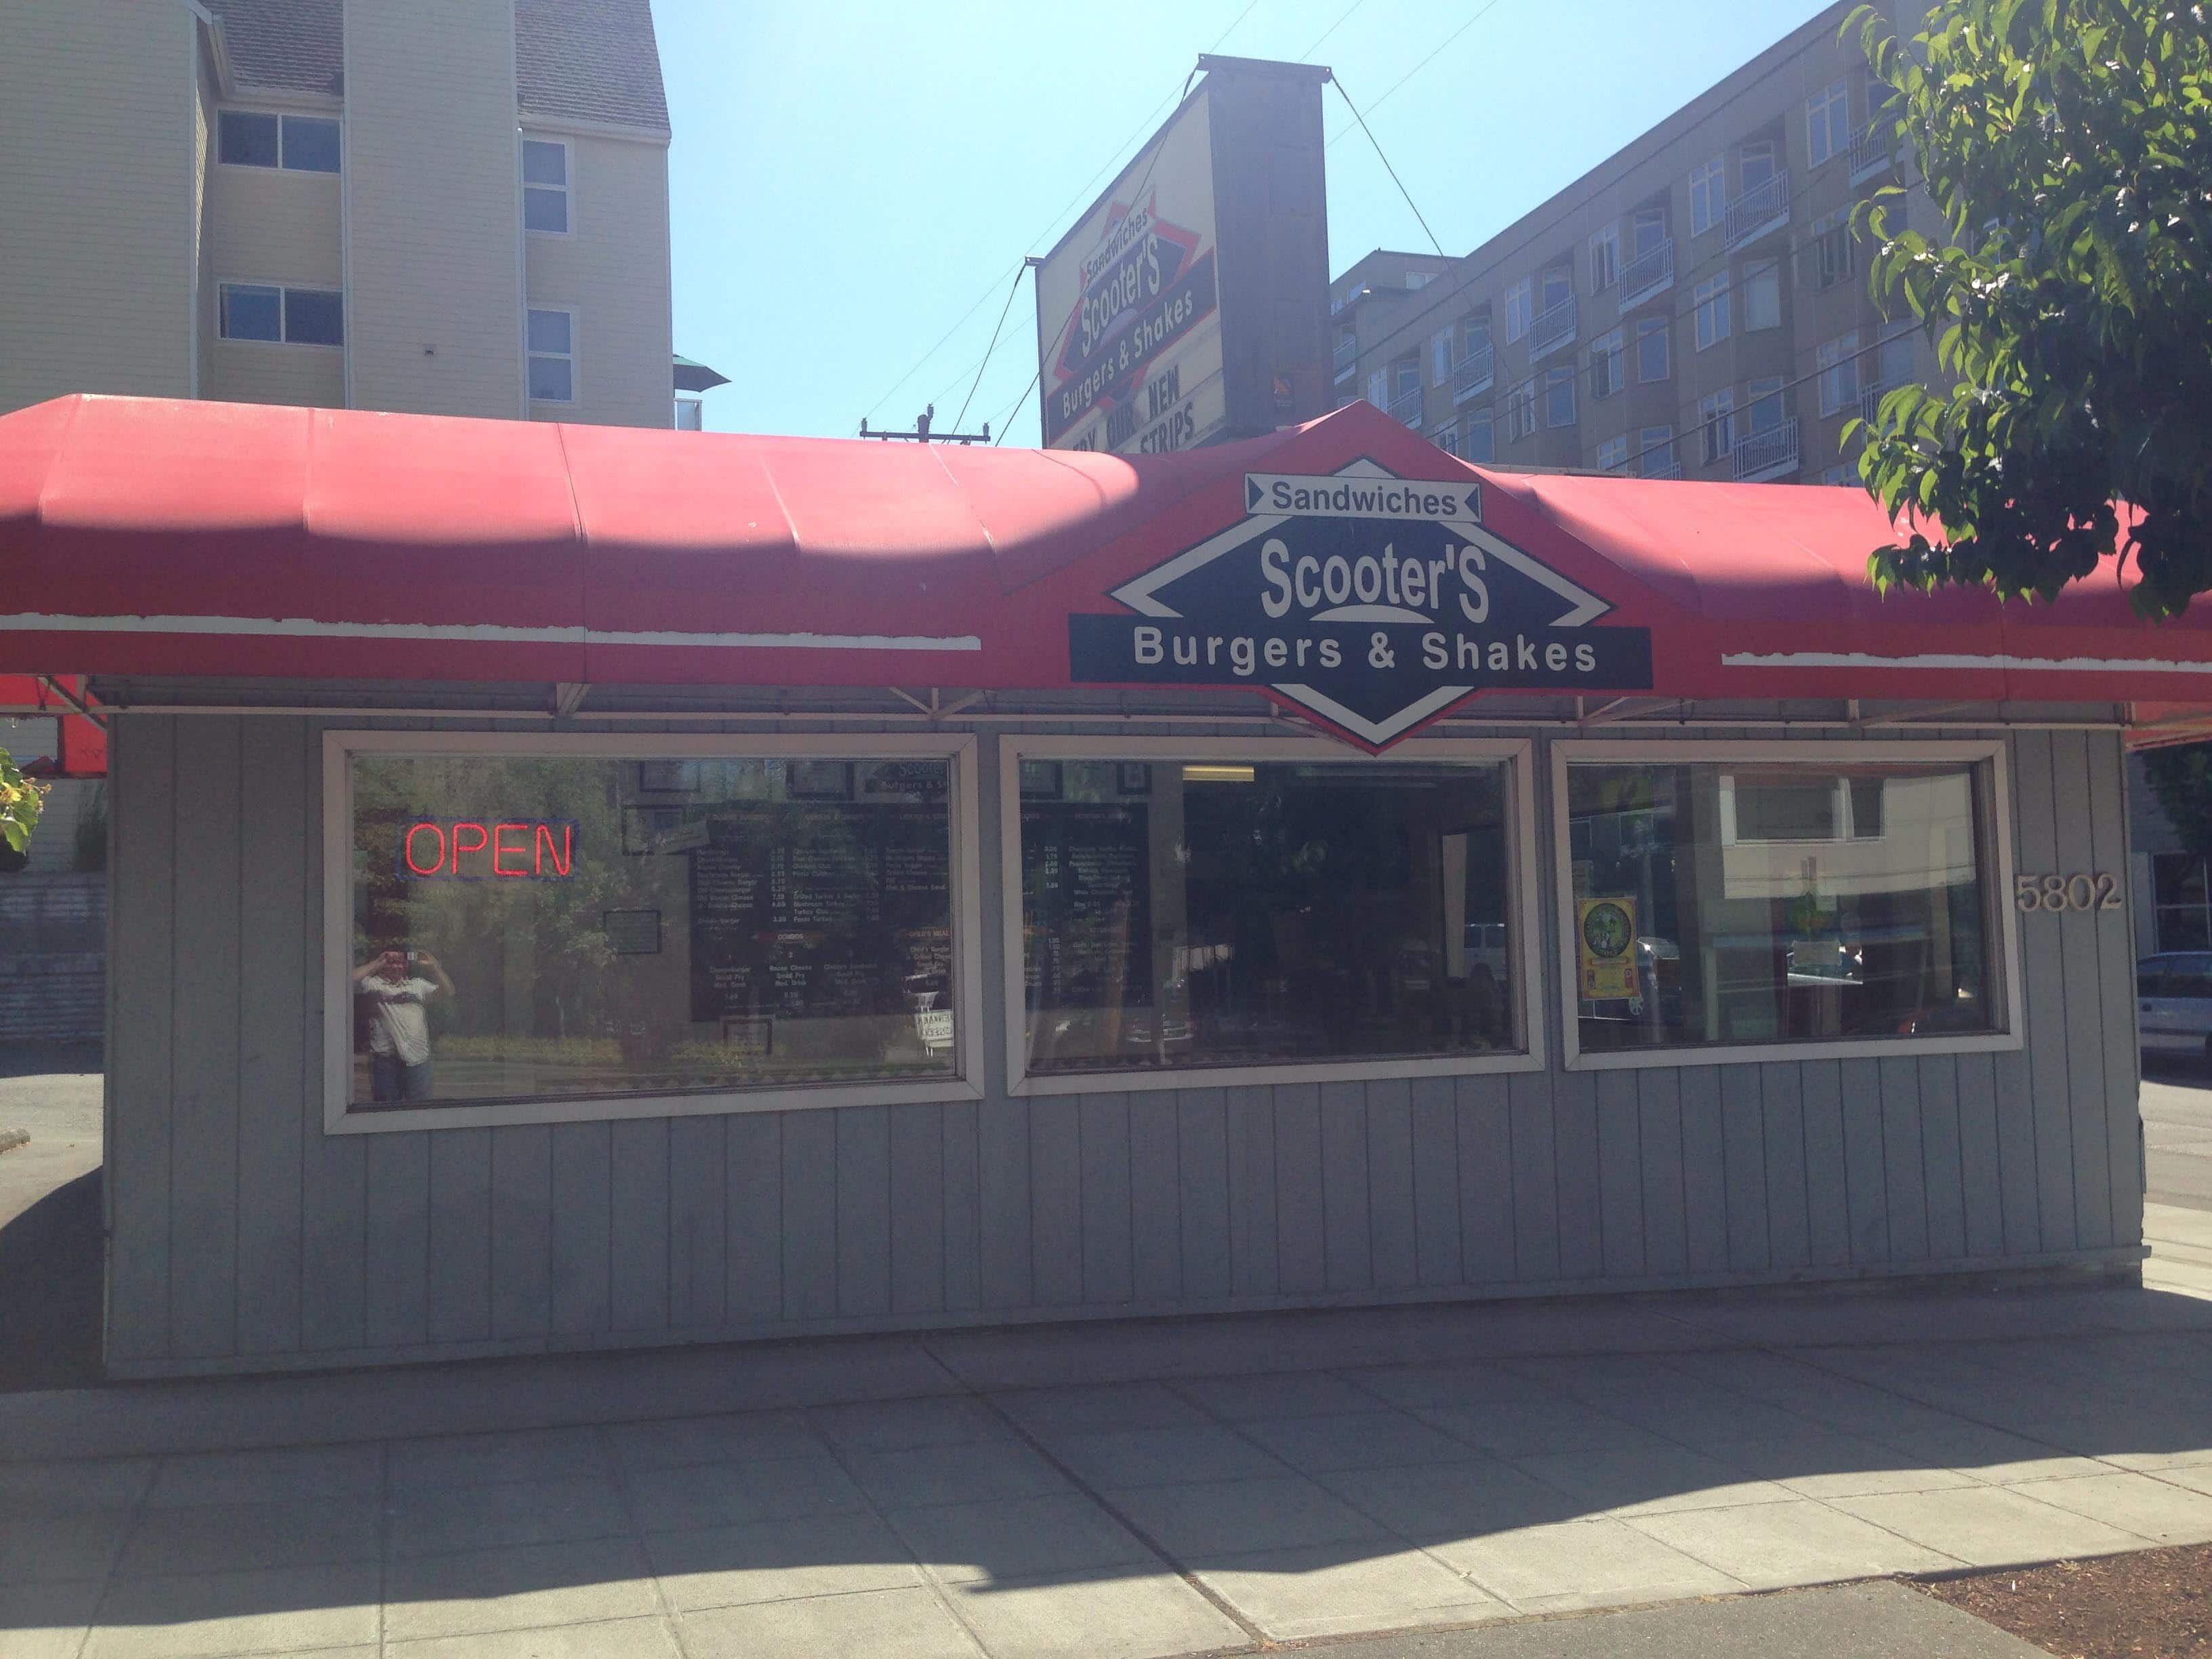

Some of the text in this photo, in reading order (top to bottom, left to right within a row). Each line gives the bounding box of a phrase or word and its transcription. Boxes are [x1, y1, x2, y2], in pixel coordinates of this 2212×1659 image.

[1086, 207, 1147, 282] Sandwiches
[1063, 289, 1193, 419] Burgers & Shakes
[1148, 365, 1180, 420] NEW
[1141, 402, 1193, 453] STRIPS
[1272, 481, 1457, 516] Sandwiches
[1261, 539, 1489, 623] Scooter'S
[1133, 626, 1596, 676] Burgers & Shakes
[405, 823, 571, 876] OPEN
[2016, 872, 2123, 913] 5802
